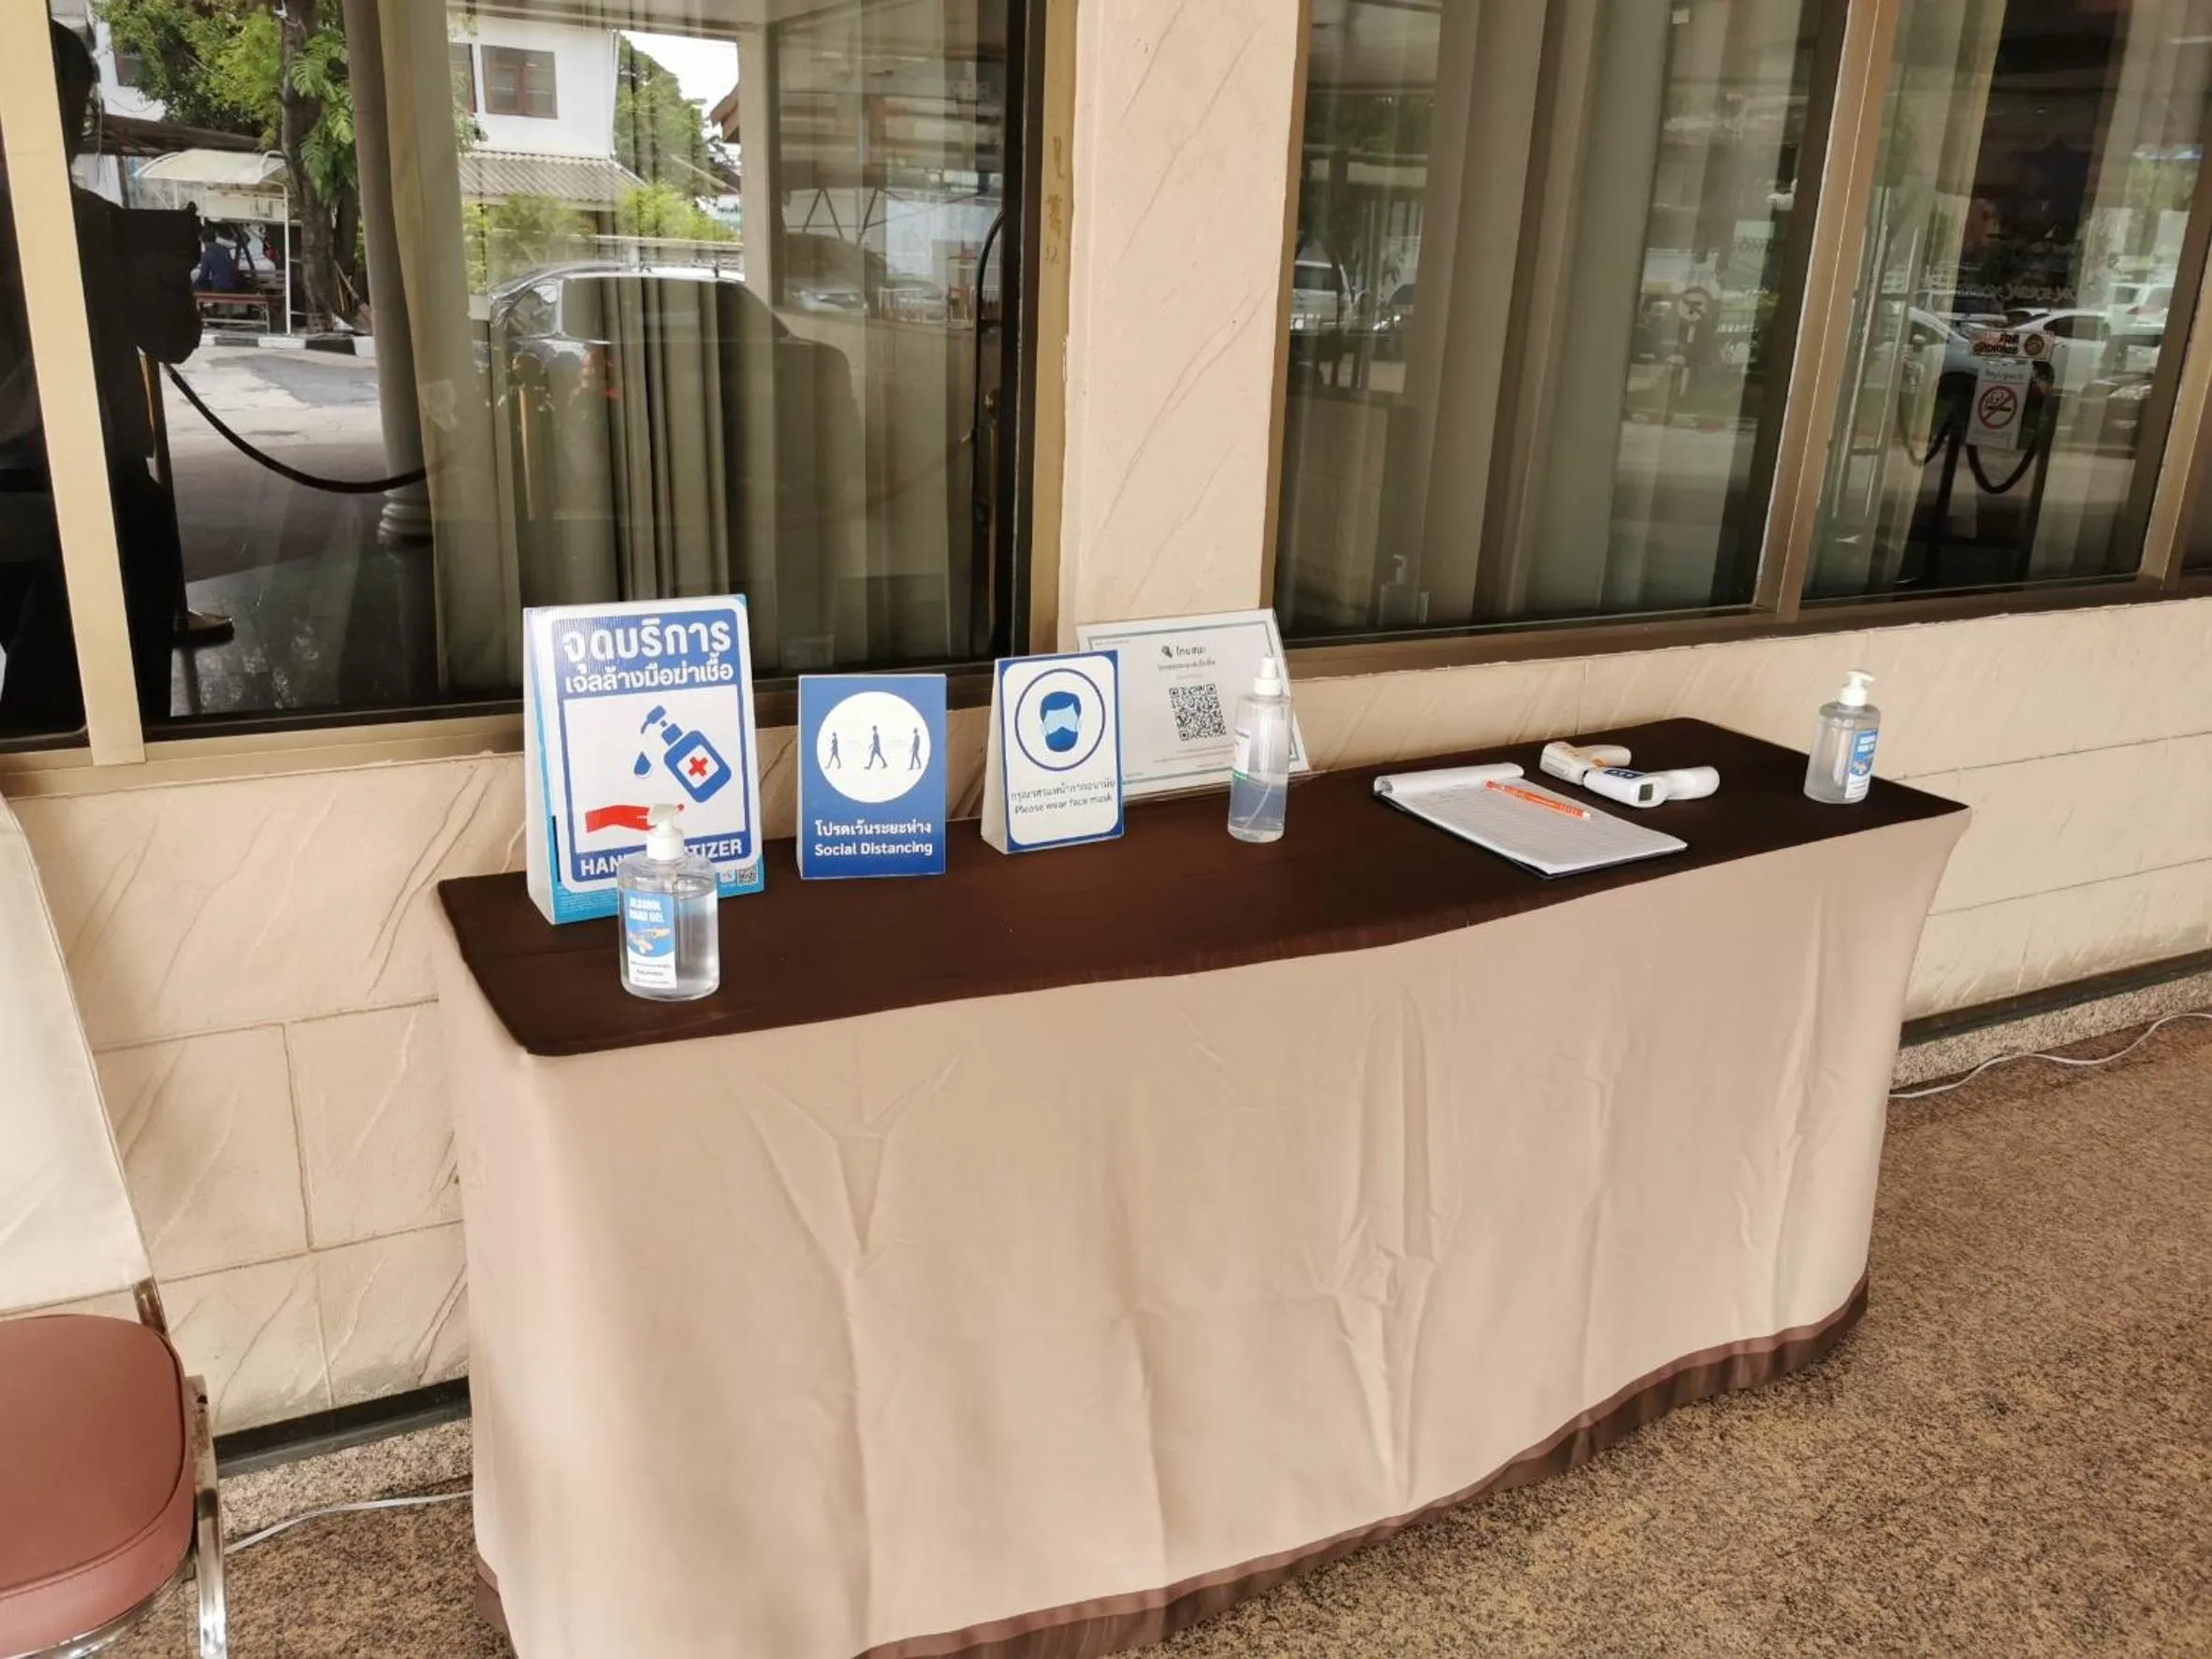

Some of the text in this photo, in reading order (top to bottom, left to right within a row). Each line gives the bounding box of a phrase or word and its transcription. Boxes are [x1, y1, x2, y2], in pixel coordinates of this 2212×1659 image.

[562, 618, 732, 674] จุดบริการ
[565, 652, 735, 693] เจลล้างมือฆ่าเชื้อ
[1014, 793, 1113, 814] Please wear face mask
[814, 818, 932, 837] โปรดเว้นระยะห่าง
[815, 841, 933, 856] Social Distancing
[580, 854, 626, 877] HAN
